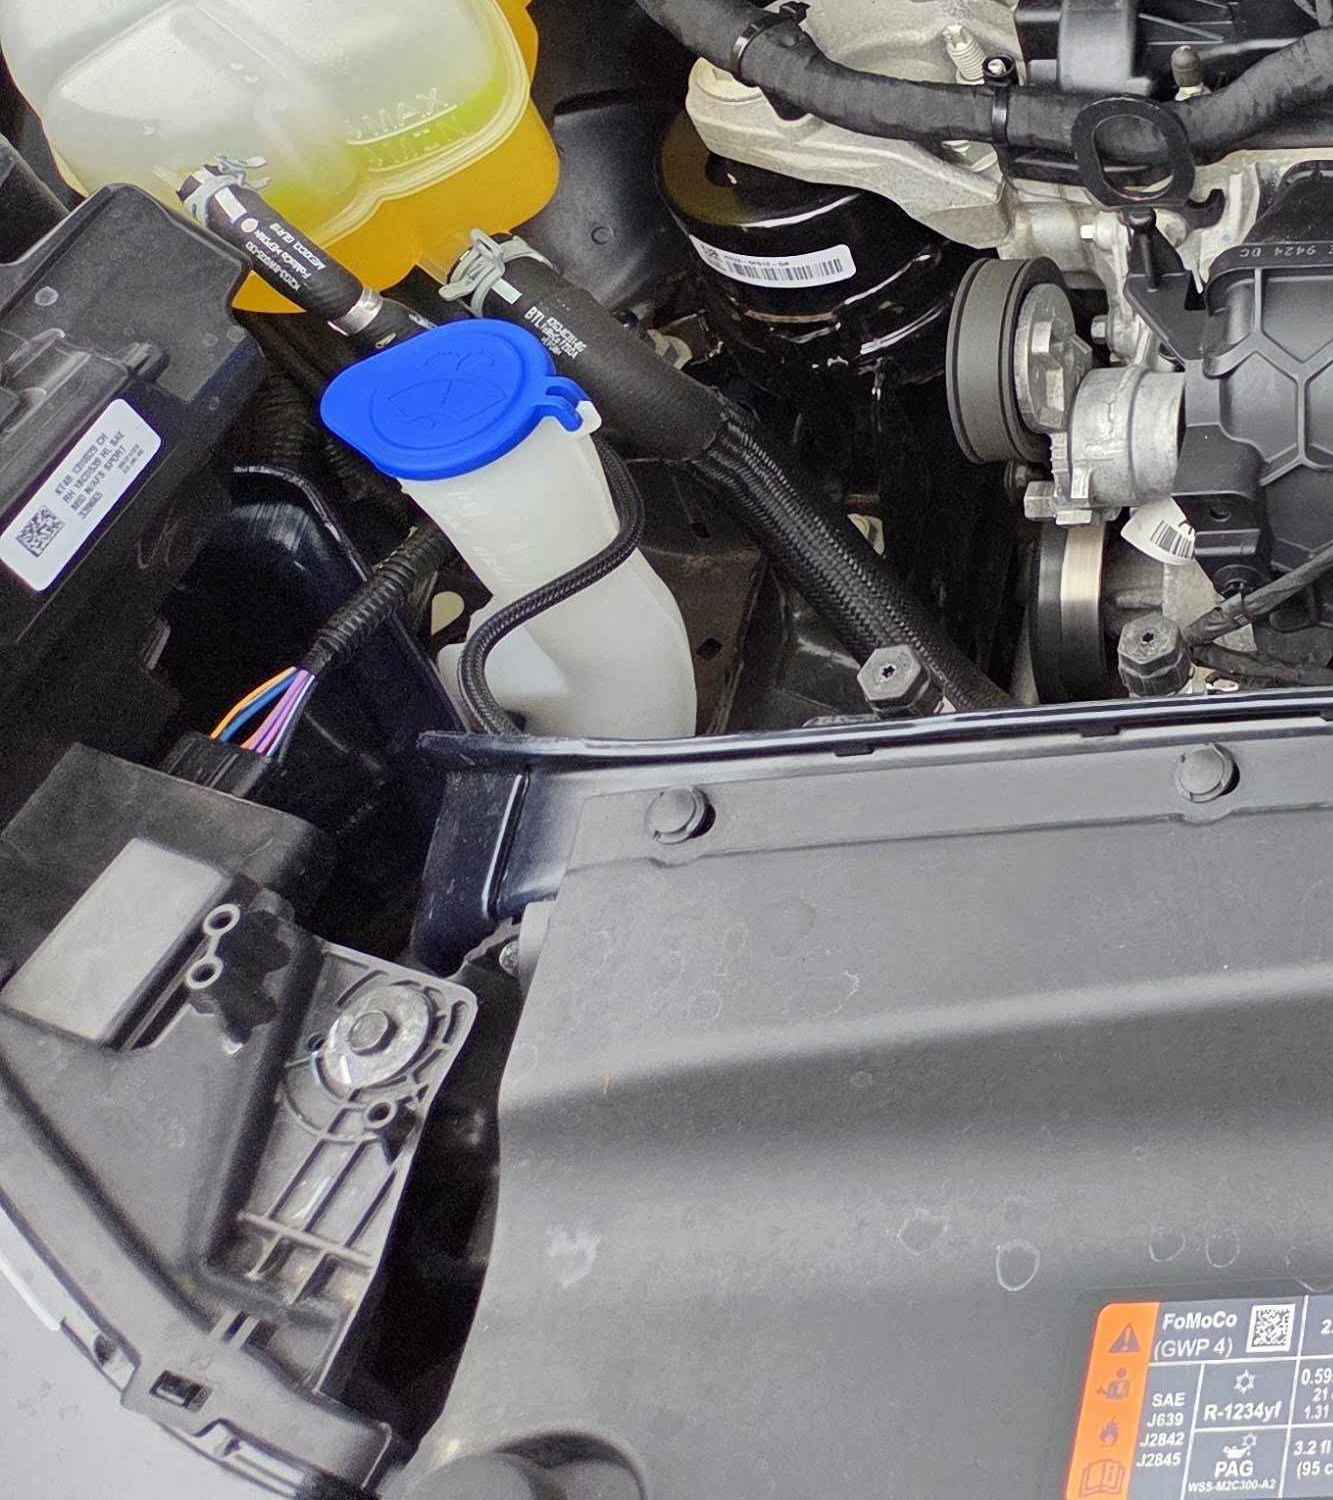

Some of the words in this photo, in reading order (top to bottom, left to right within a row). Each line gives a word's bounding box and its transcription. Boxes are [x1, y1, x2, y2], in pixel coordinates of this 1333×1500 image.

[361, 88, 448, 136] MAX
[1274, 245, 1316, 257] 9424
[95, 432, 108, 447] CH
[103, 444, 128, 472] SPORT
[1162, 1311, 1238, 1330] FoMoCo
[1154, 1338, 1210, 1361] (GWP
[1213, 1337, 1233, 1358] 4)
[1152, 1392, 1186, 1408] SAE
[1313, 1387, 1329, 1401] 21
[1146, 1412, 1184, 1427] J639
[1203, 1401, 1283, 1423] R-1234yf
[1303, 1405, 1329, 1420] 1.31
[1139, 1432, 1185, 1448] J2842
[1293, 1441, 1316, 1456] 3.2
[1320, 1440, 1332, 1454] fl
[1136, 1452, 1181, 1467] J2845
[1214, 1460, 1254, 1478] PAG
[1296, 1460, 1321, 1480] (95
[1188, 1478, 1276, 1493] WSS-M2C300-A2
